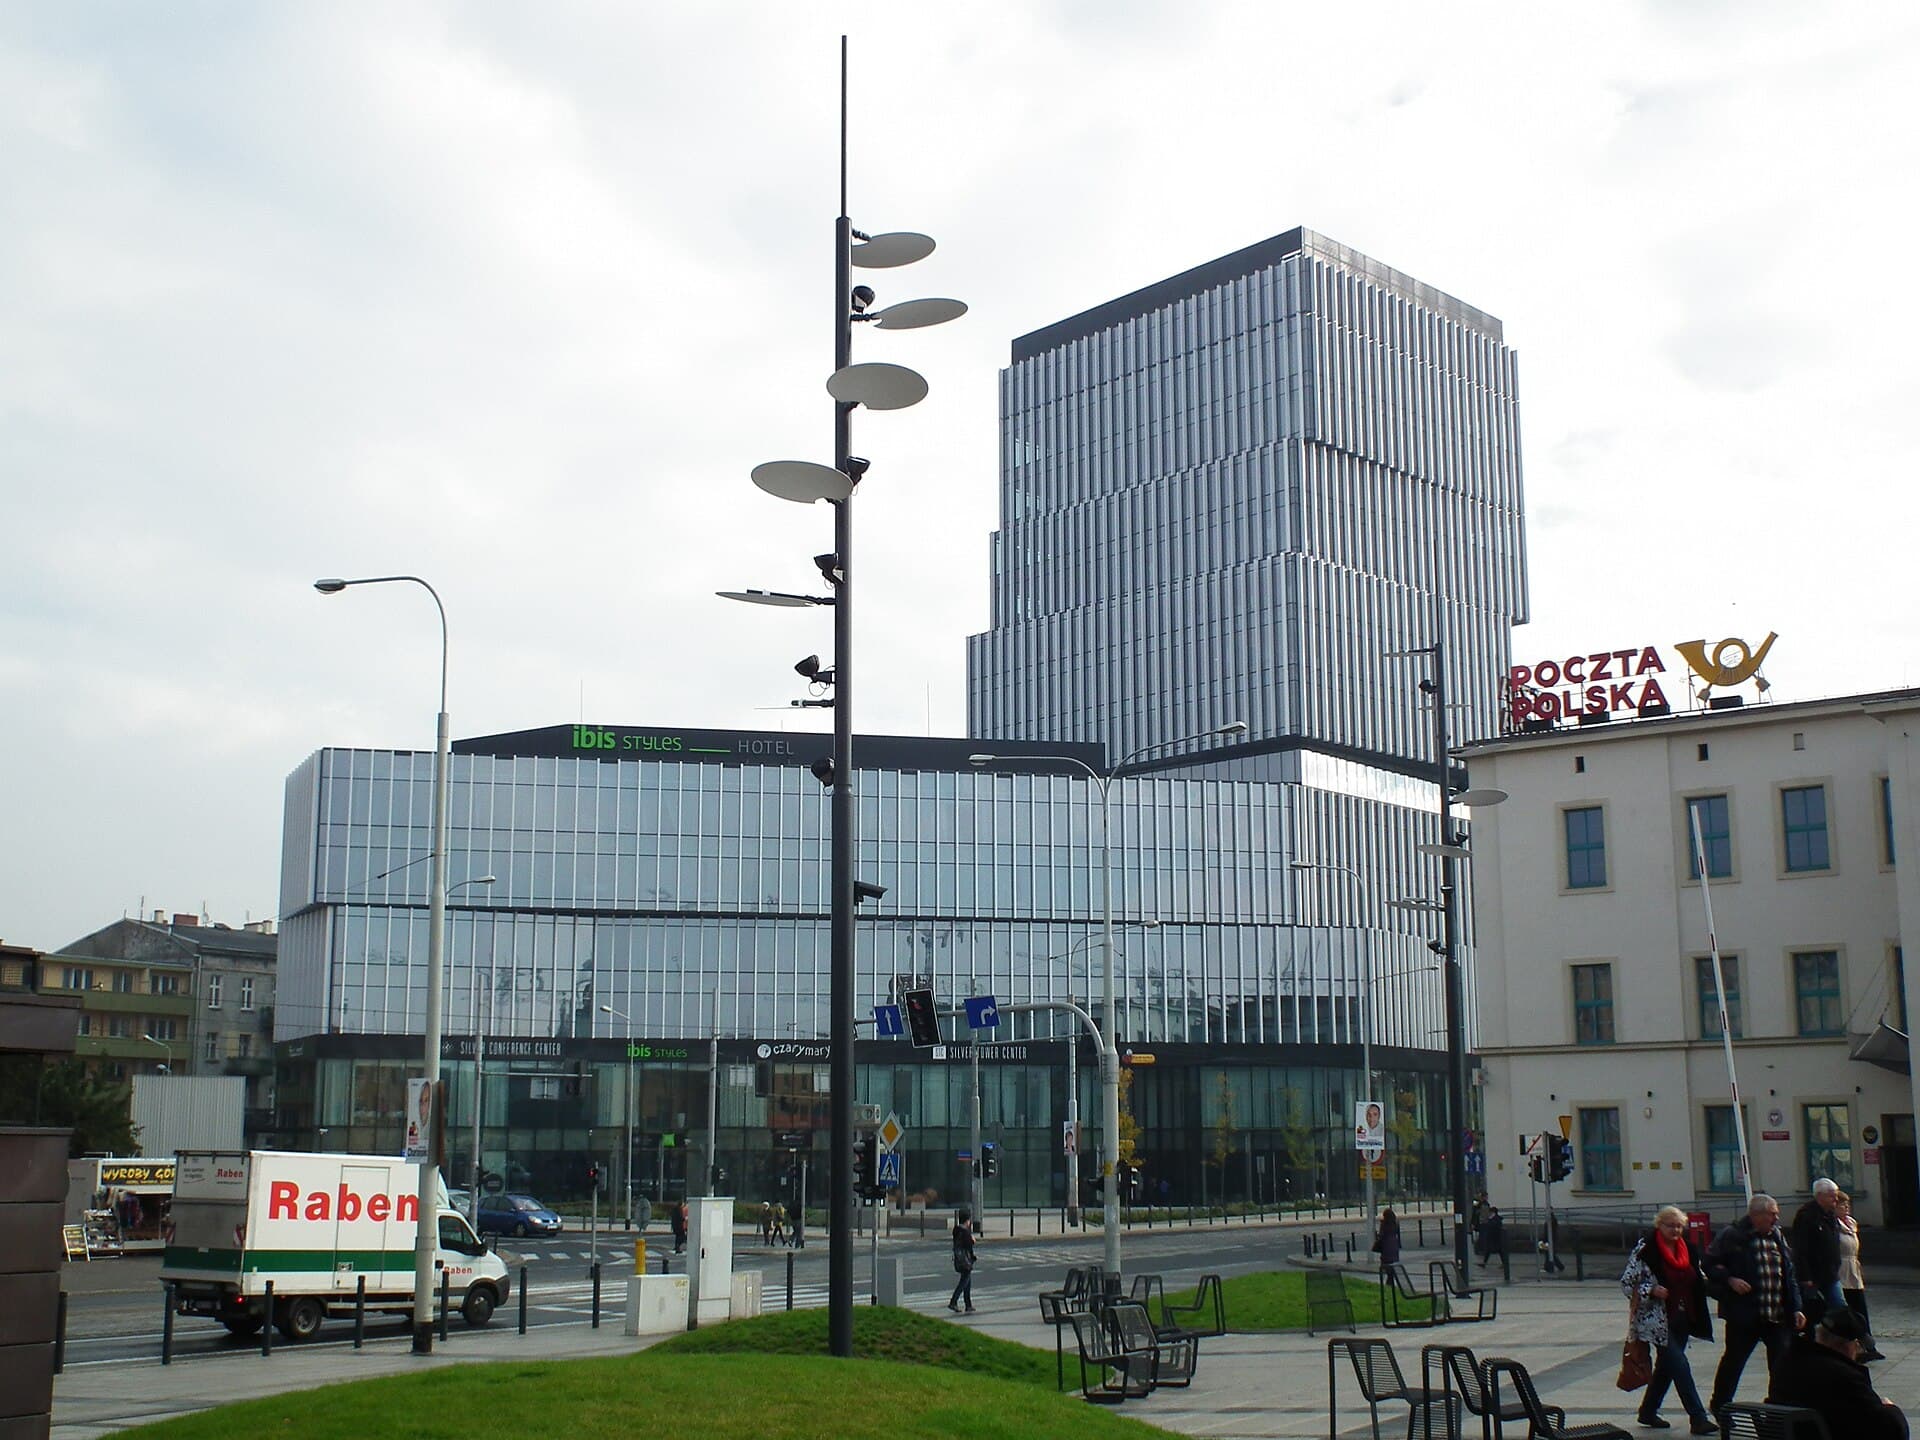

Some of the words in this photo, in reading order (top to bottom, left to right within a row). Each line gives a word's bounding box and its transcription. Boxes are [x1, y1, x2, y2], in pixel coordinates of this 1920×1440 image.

[1511, 646, 1666, 692] POCZTA
[1511, 679, 1669, 725] POLSKA
[573, 725, 616, 749] ibis
[738, 739, 795, 755] HOTEL
[489, 1042, 531, 1055] CONFERENCE
[534, 1042, 561, 1056] CENTER
[627, 1043, 652, 1057] ibis
[1001, 1046, 1027, 1059] CENTER
[102, 1167, 151, 1181] WYROBY
[216, 1168, 244, 1178] Raben
[268, 1181, 420, 1222] Raben
